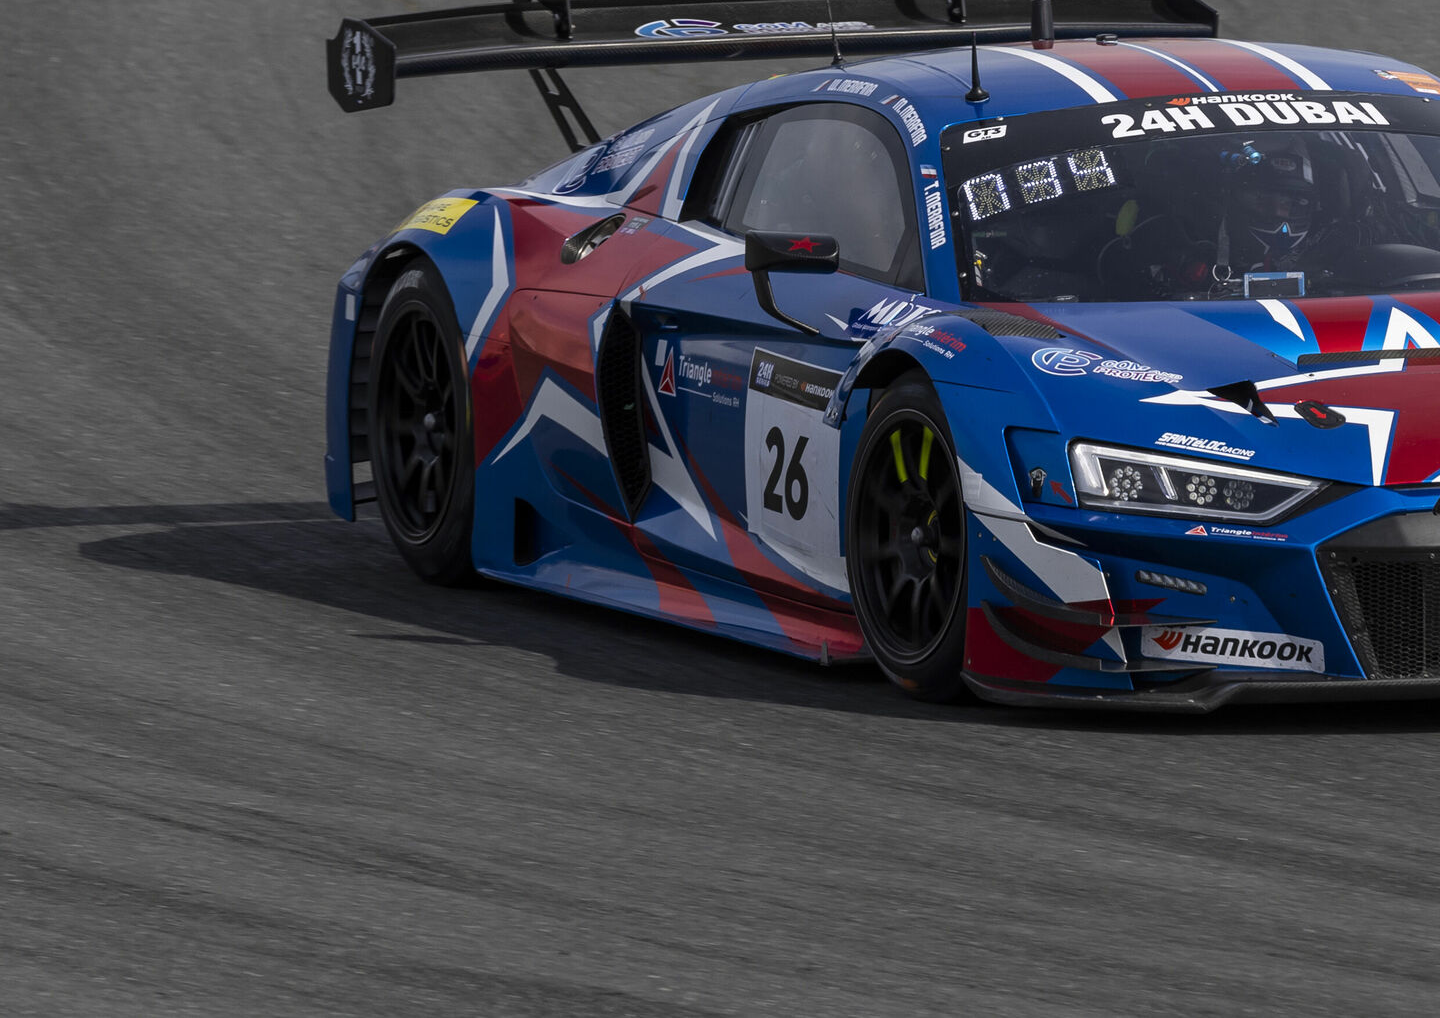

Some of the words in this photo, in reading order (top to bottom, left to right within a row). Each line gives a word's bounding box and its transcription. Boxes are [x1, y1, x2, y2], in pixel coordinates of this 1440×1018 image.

[967, 127, 1001, 138] GT3
[1101, 105, 1216, 139] 24H
[1218, 101, 1391, 126] DUBAI
[758, 361, 774, 379] 24H
[763, 426, 810, 521] 26
